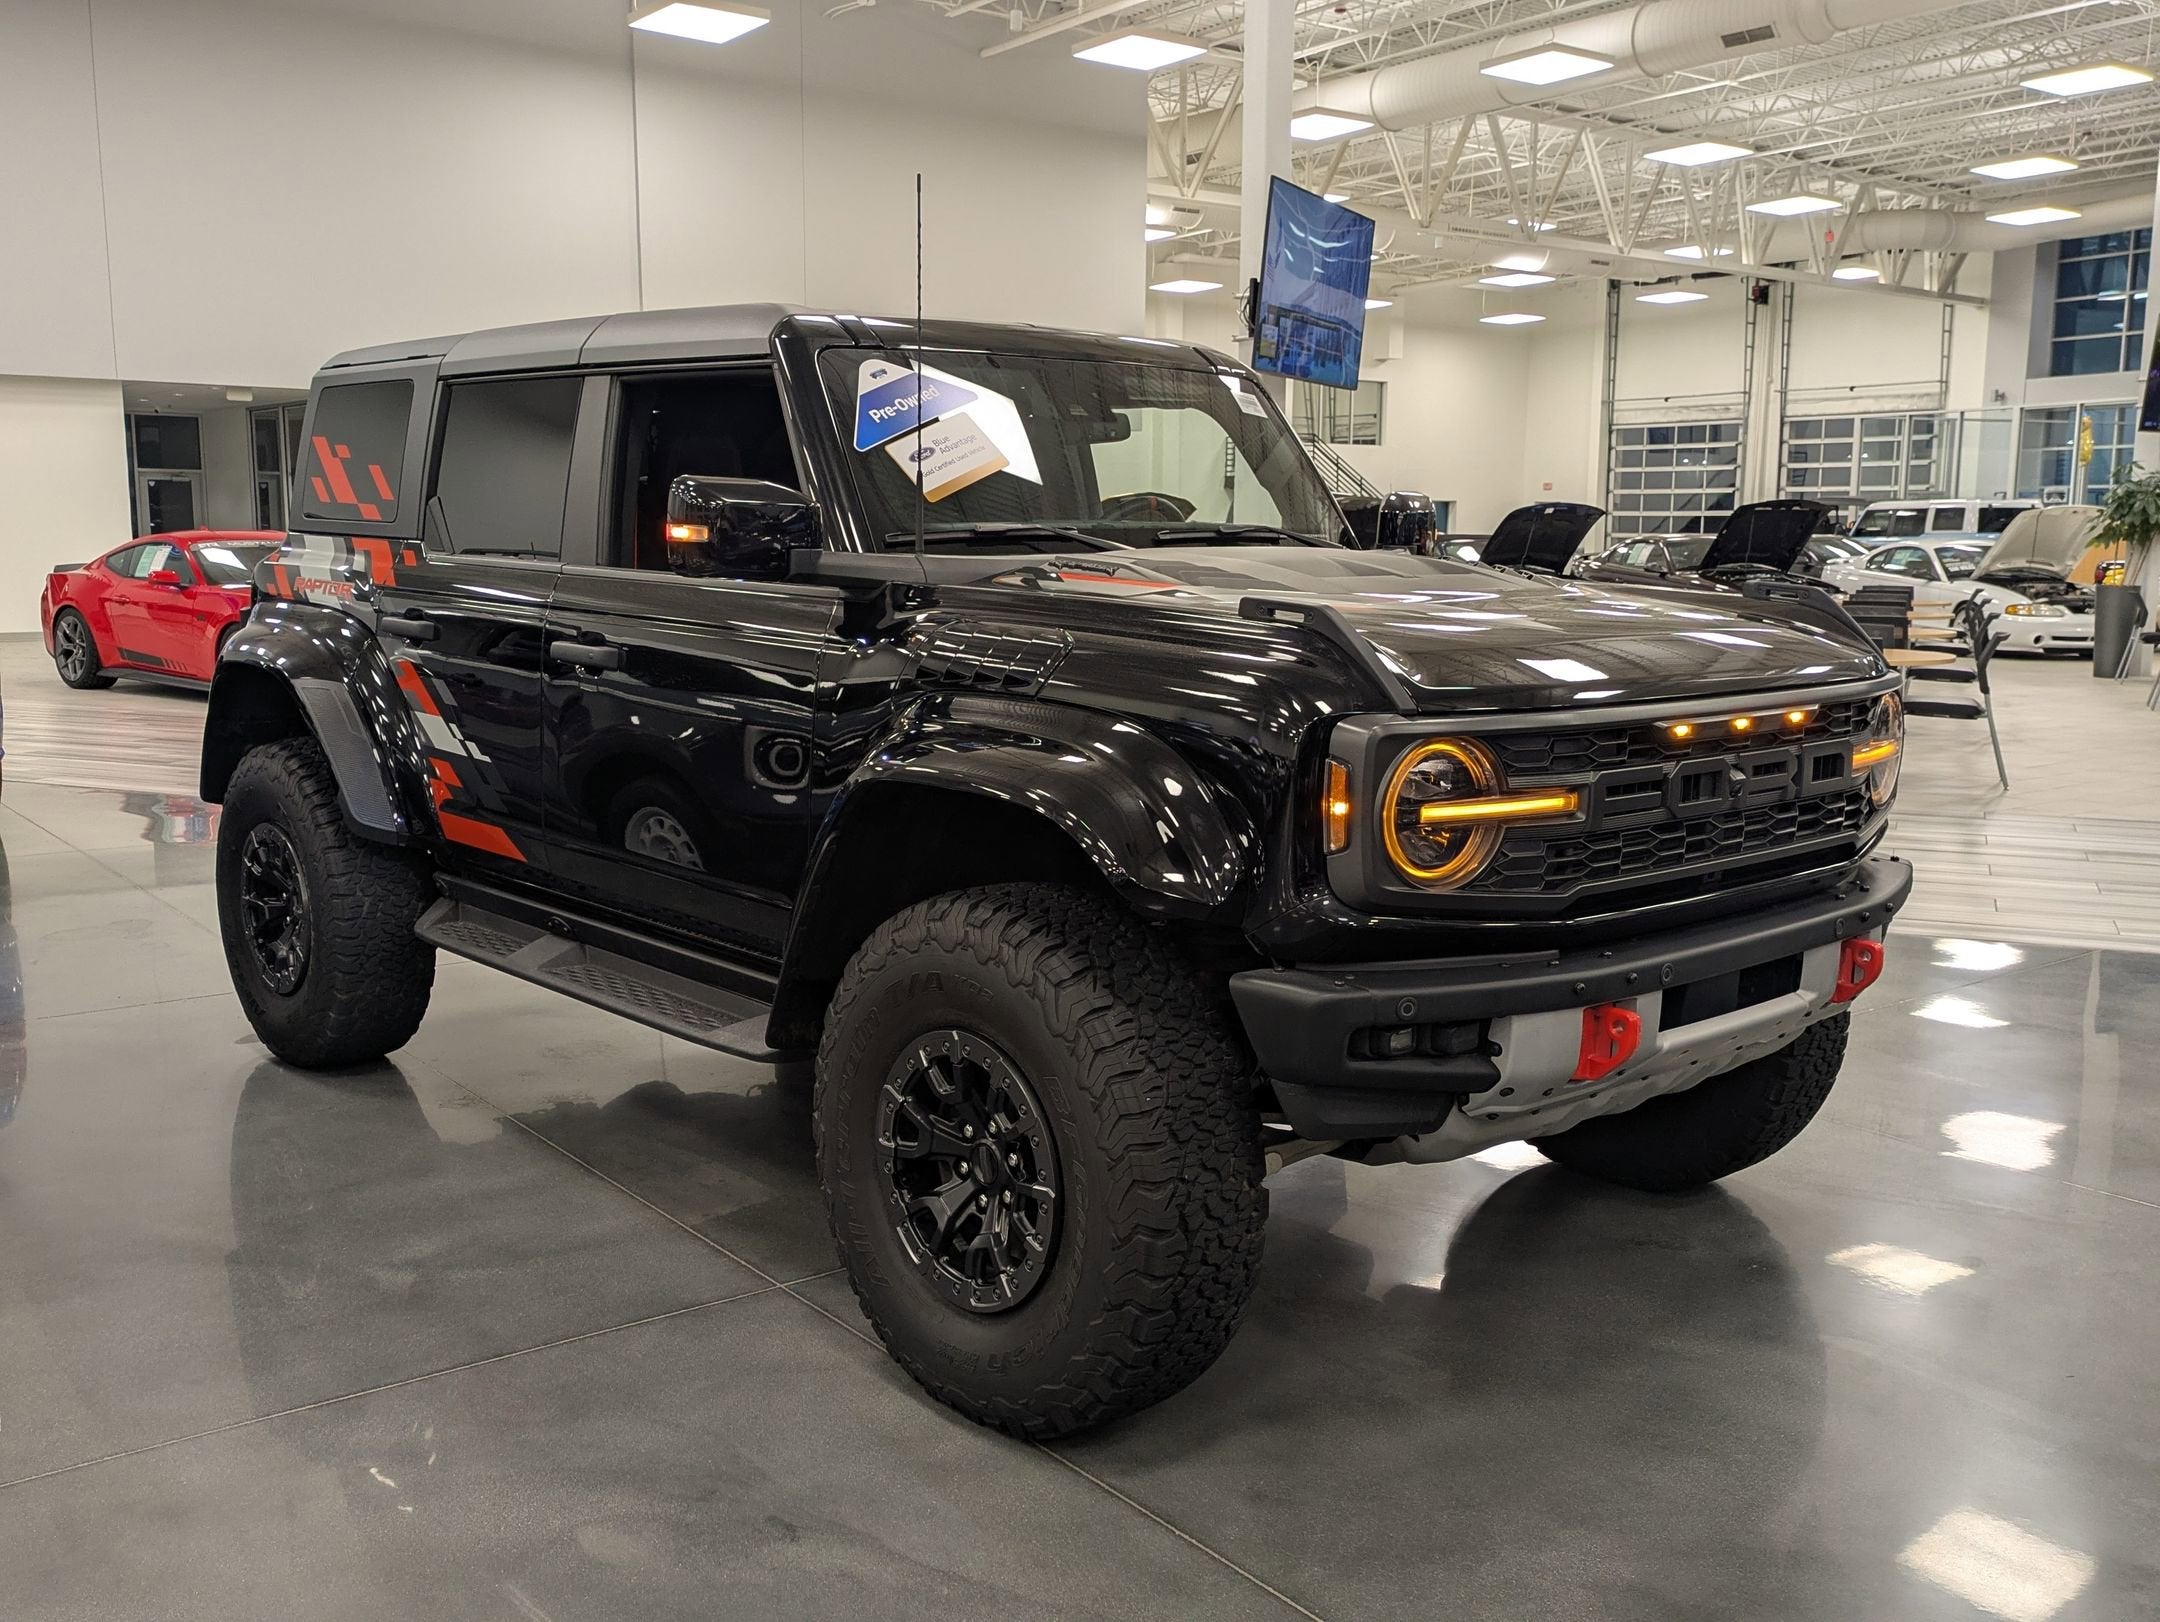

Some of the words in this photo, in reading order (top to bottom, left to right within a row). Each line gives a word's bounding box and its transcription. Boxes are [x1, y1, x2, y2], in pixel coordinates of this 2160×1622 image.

[868, 384, 940, 424] Pre-Owned
[932, 435, 949, 448] Blue
[939, 434, 977, 455] Advantage
[934, 458, 956, 472] Certified
[295, 576, 354, 601] RAPTOR
[1591, 737, 1853, 832] FORD
[883, 970, 945, 1008] T/A
